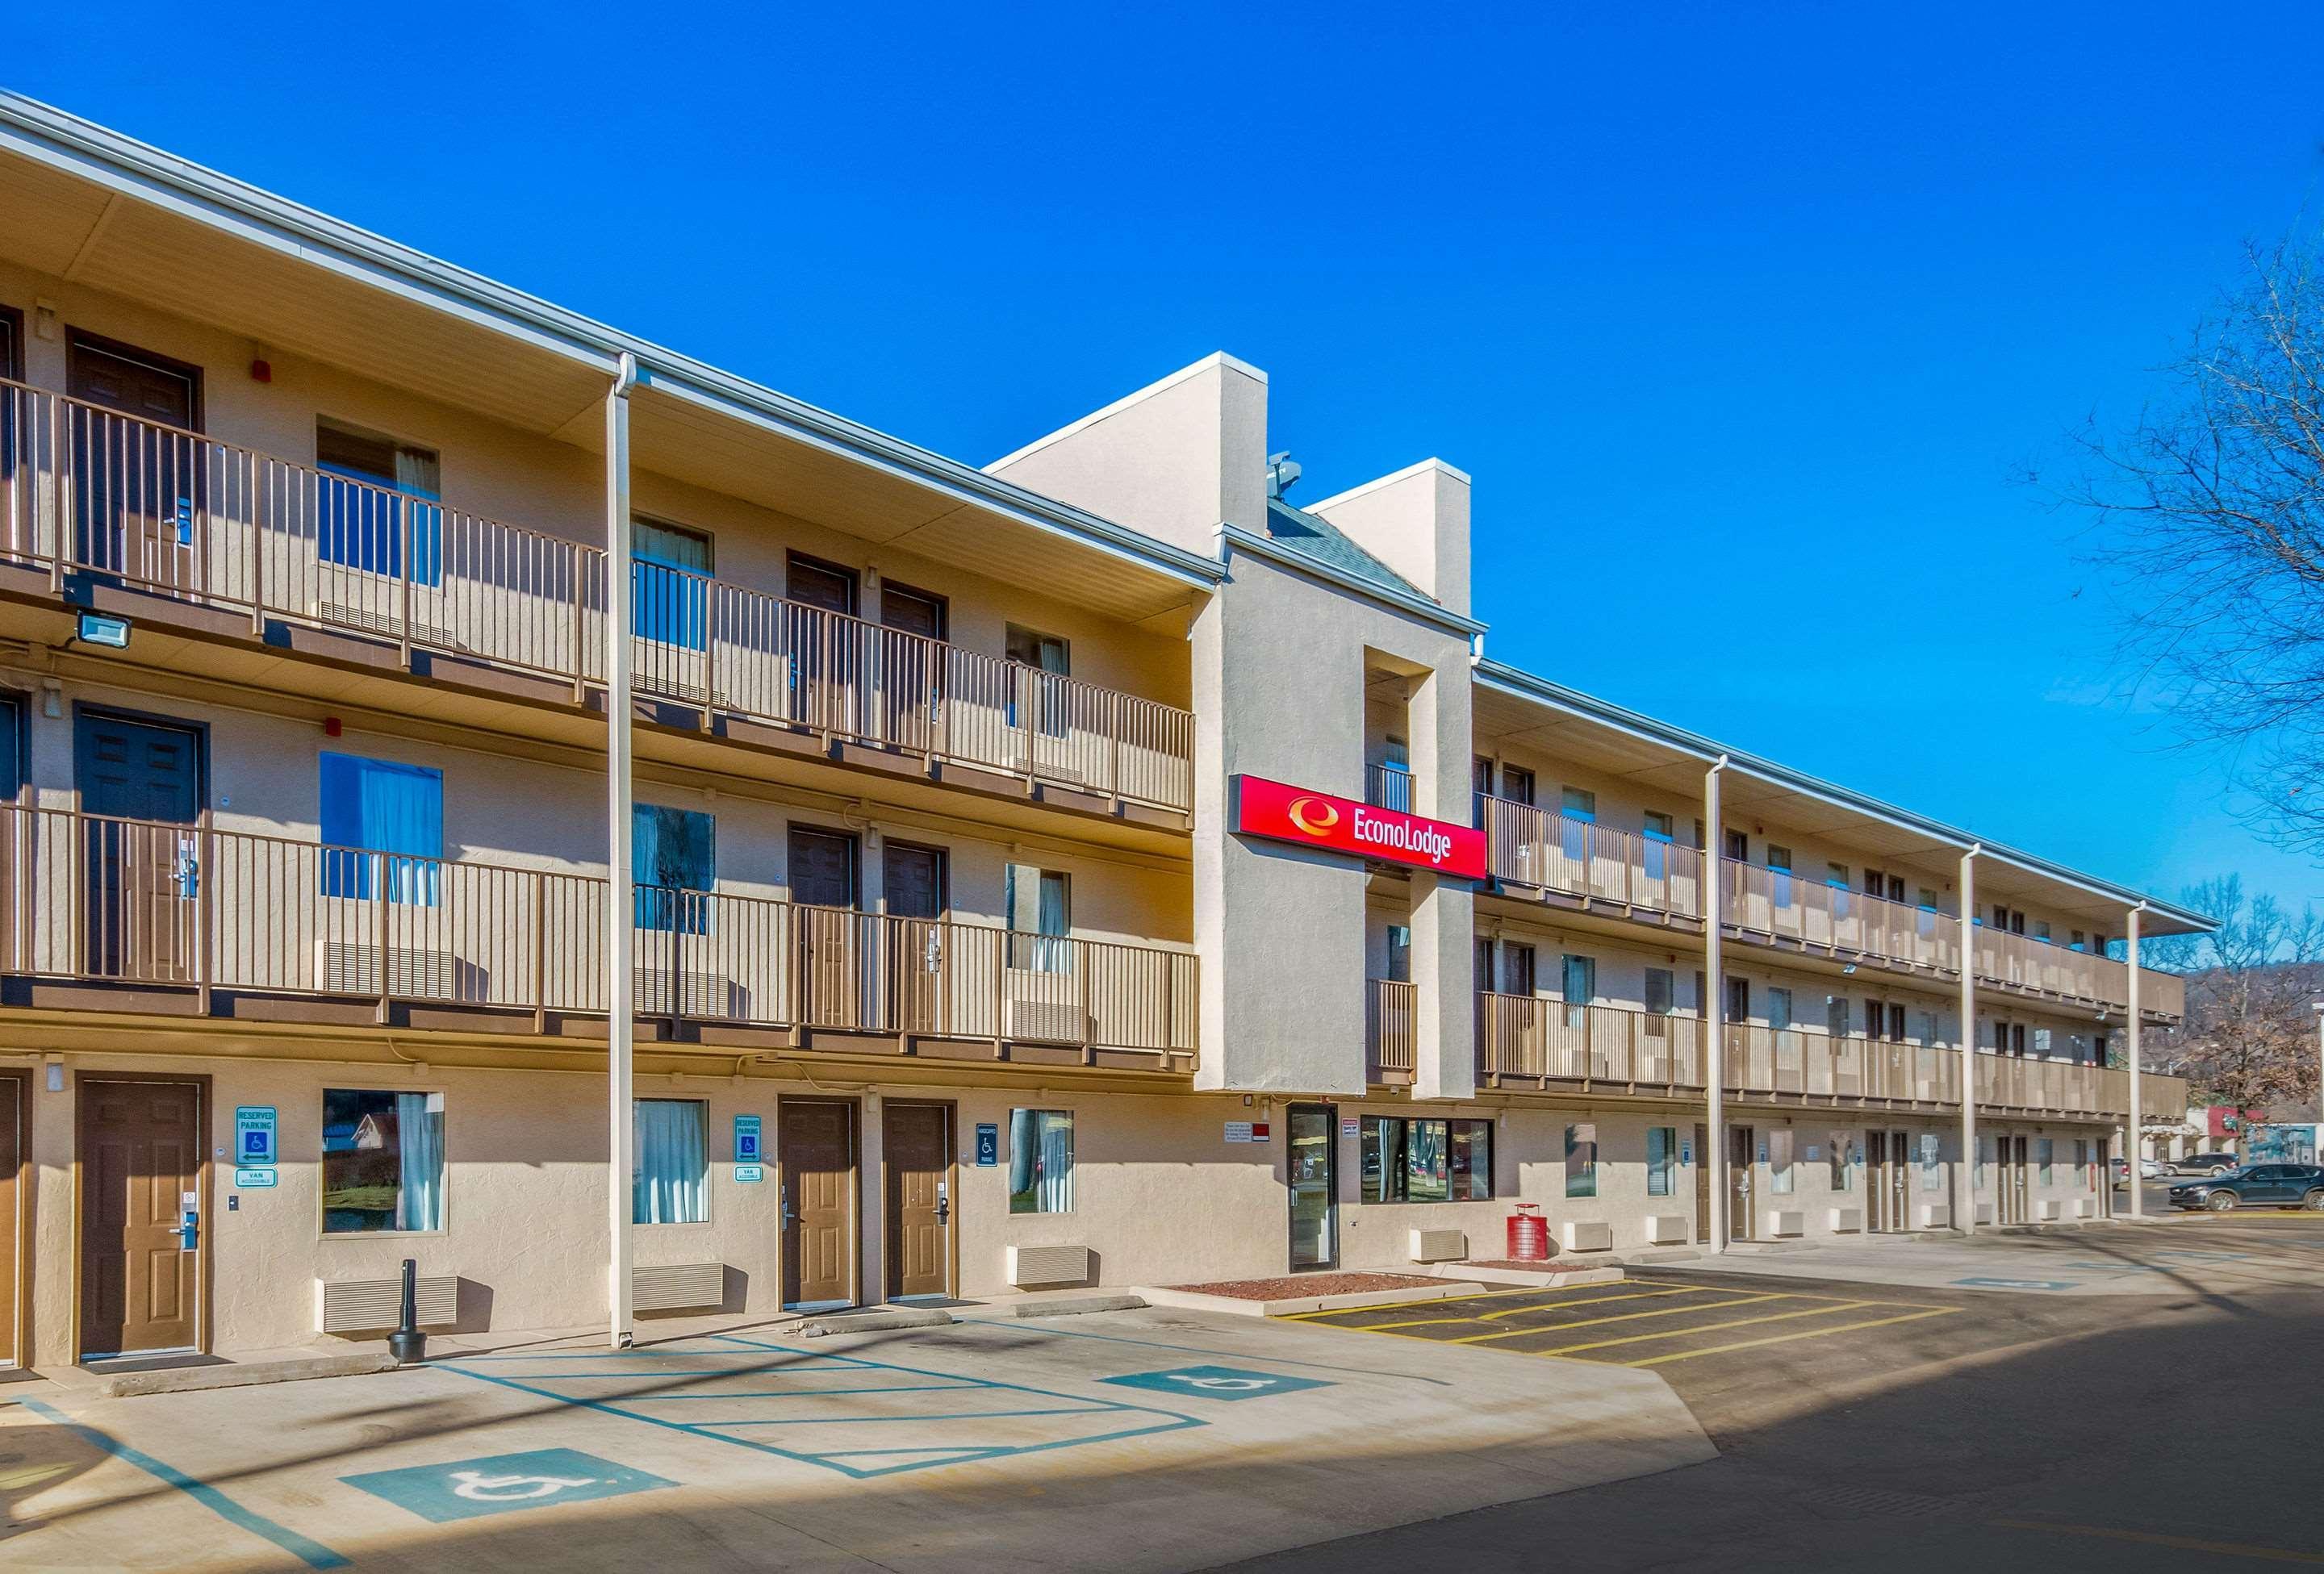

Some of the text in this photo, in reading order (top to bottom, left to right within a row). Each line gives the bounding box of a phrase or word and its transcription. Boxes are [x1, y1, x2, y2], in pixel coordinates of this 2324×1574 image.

[1354, 808, 1451, 863] EconoLodge
[238, 1112, 274, 1120] RESERVED
[240, 1121, 272, 1129] PARKING
